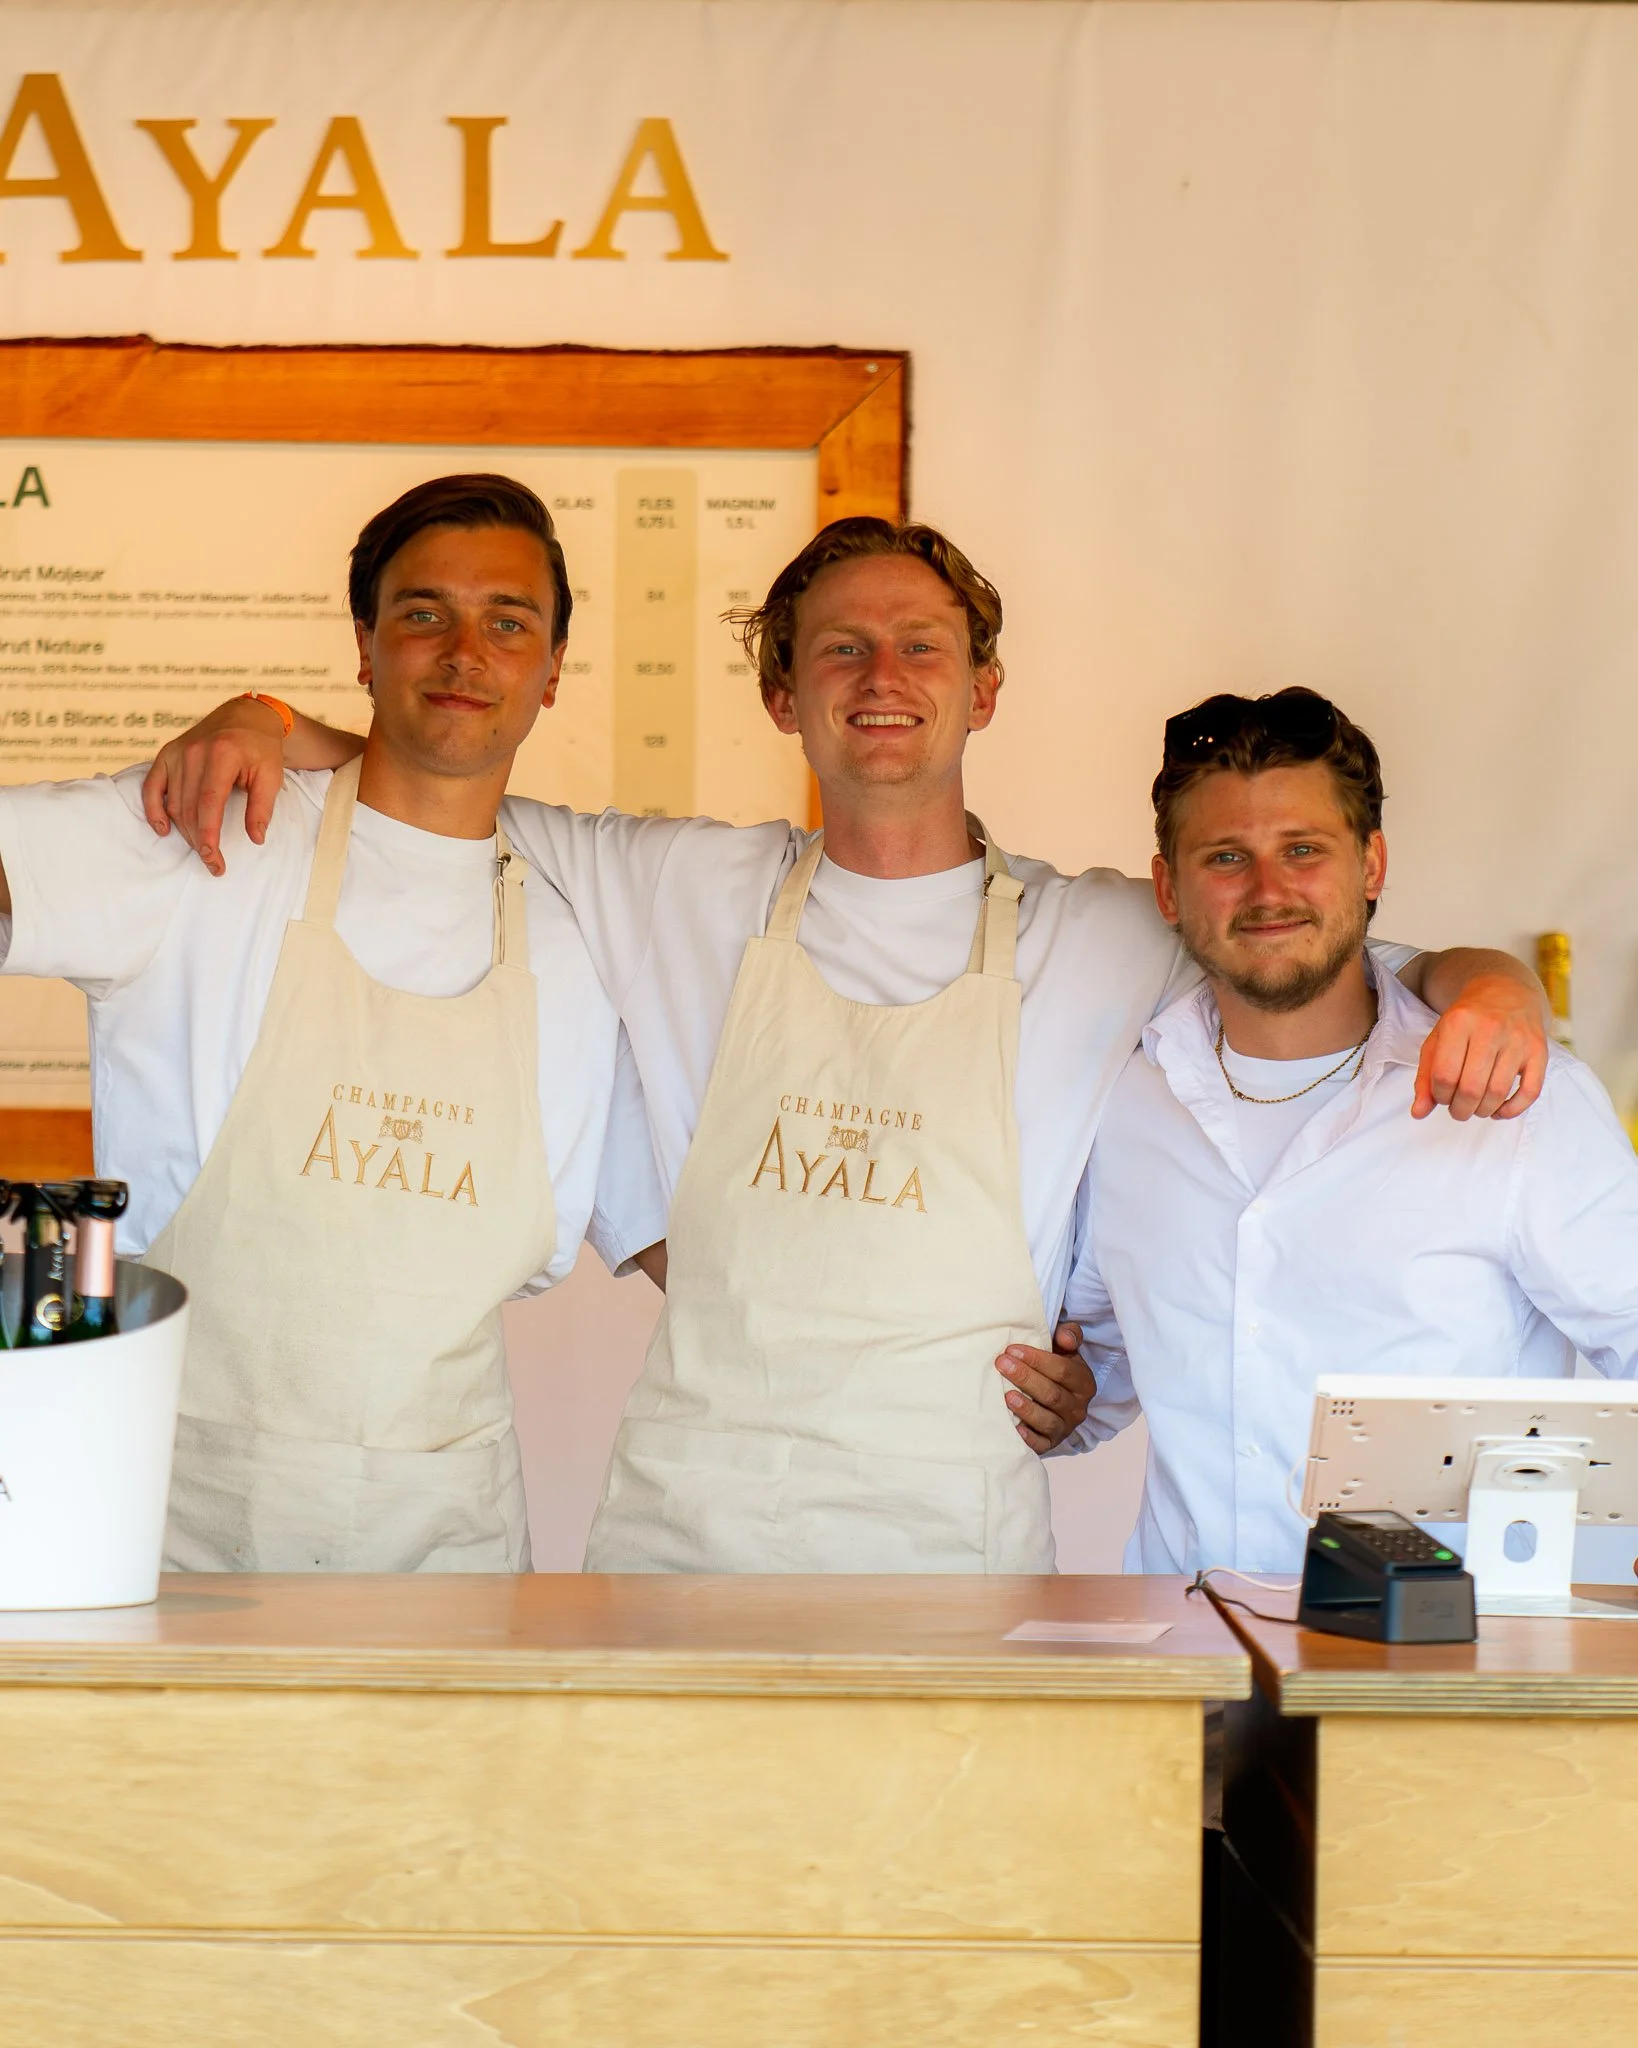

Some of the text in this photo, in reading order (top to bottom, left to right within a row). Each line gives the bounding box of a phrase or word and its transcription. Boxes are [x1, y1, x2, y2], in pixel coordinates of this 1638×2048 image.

[0, 73, 730, 264] AYALA
[553, 498, 595, 511] GLAS
[637, 498, 676, 511] FLES
[706, 499, 777, 511] MAGNUM
[636, 516, 666, 529] 0,75
[36, 566, 105, 585] Majeur
[36, 638, 105, 655] Nature
[35, 711, 58, 728] Le
[63, 710, 118, 728] Blanc
[123, 711, 148, 728] de
[332, 1084, 475, 1125] CHAMPAGNE
[780, 1095, 922, 1131] CHAMPAGNE
[299, 1104, 479, 1207] AYALA
[748, 1115, 928, 1213] AYALA
